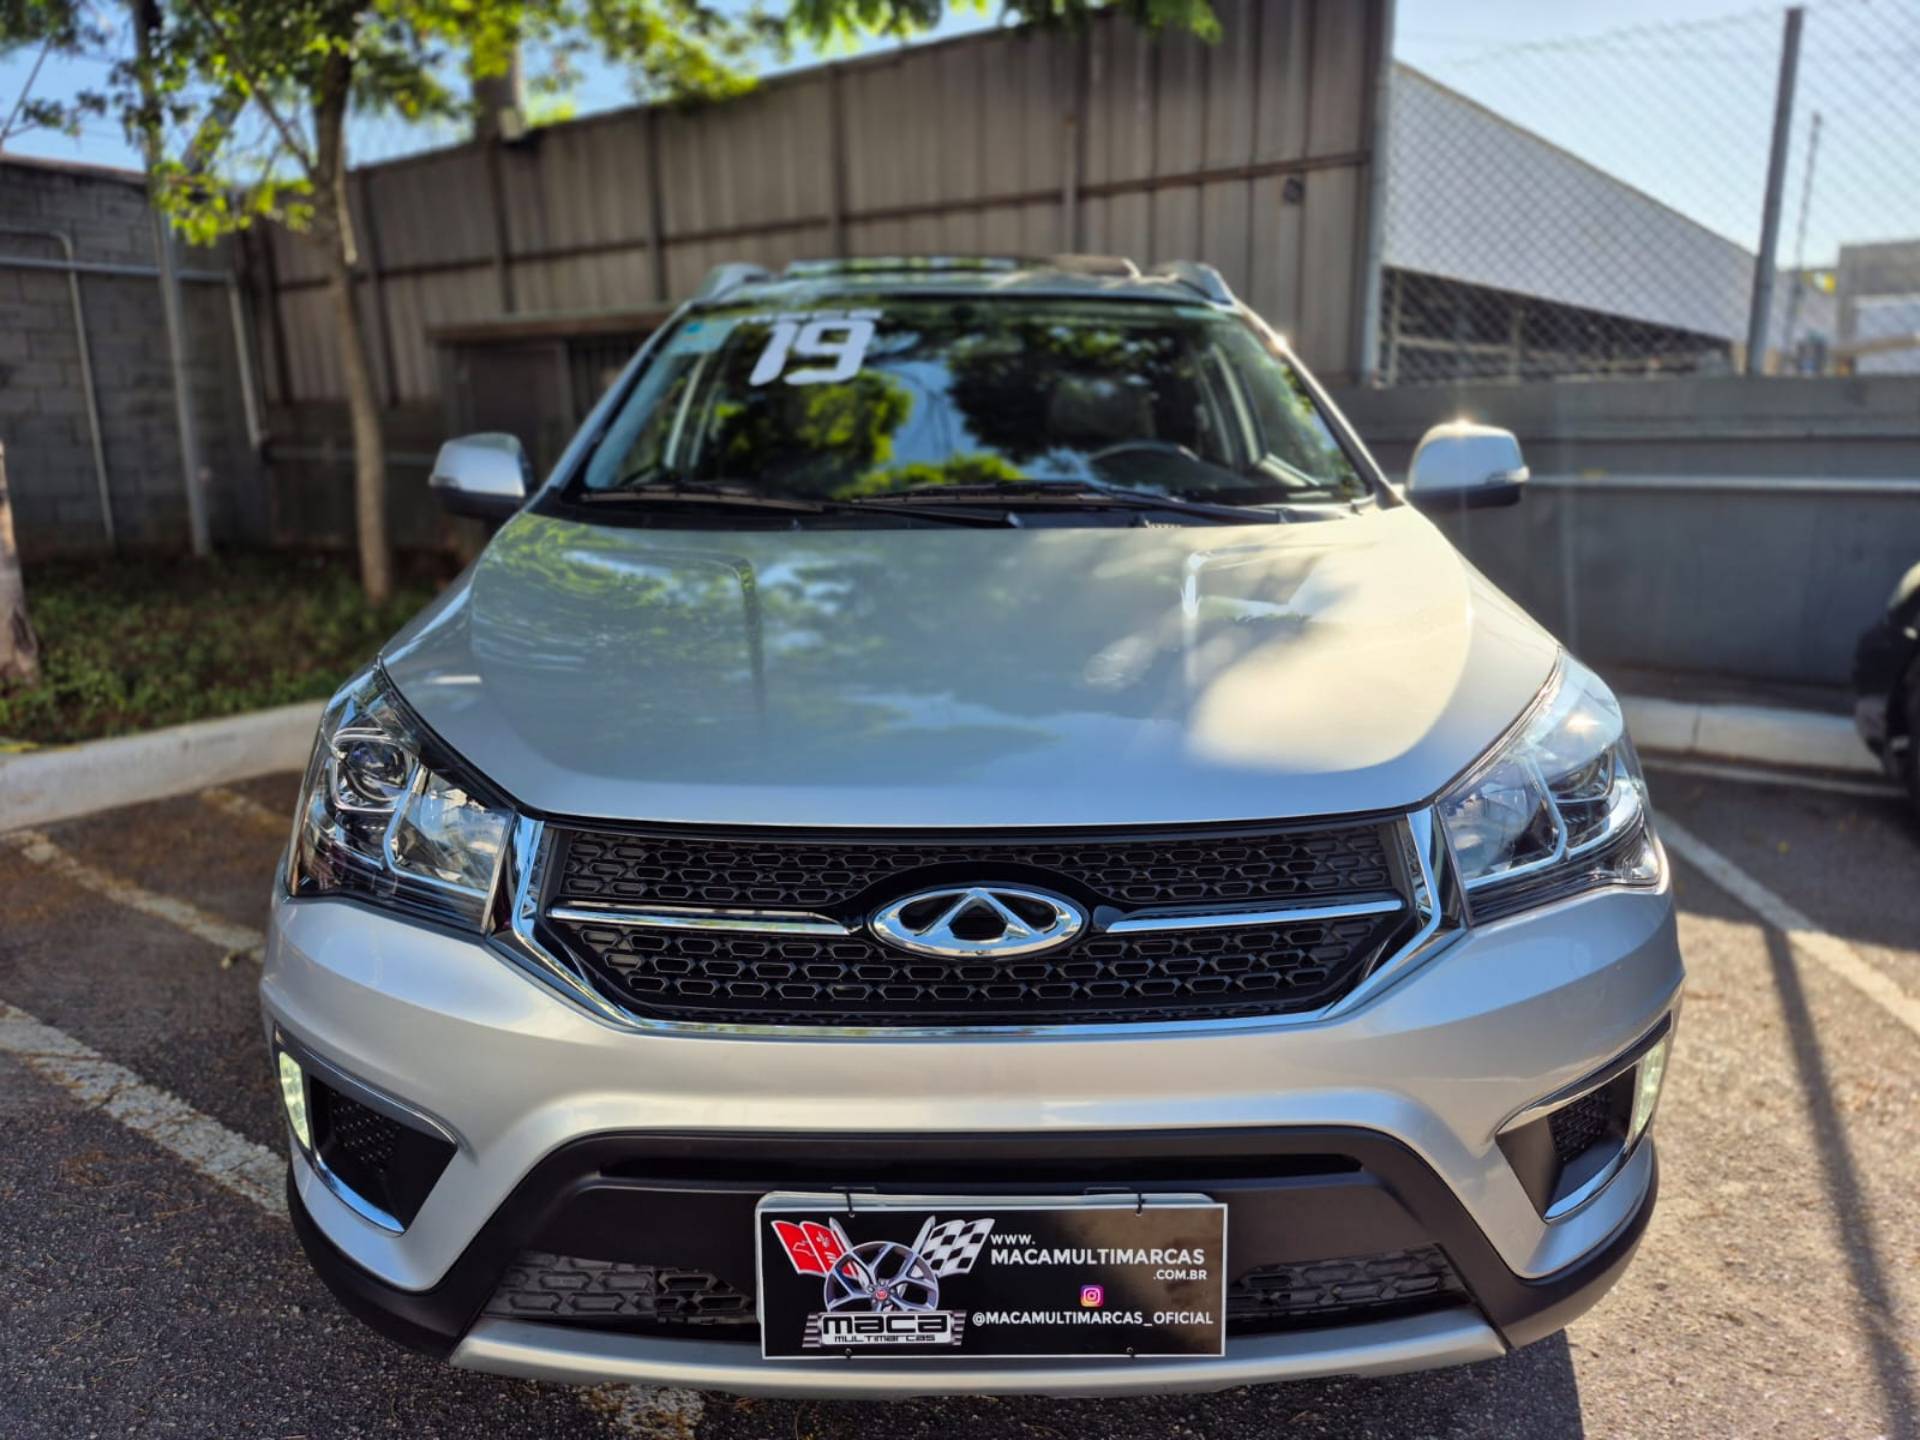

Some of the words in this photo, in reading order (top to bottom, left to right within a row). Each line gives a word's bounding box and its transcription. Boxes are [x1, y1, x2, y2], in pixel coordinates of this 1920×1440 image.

[749, 319, 875, 386] 19
[991, 1248, 1205, 1265] MACAMULTIMARCAS
[1153, 1269, 1207, 1280] .COM.BR
[972, 1311, 1214, 1327] @MACAMULTIMARCAS_OFICIAL
